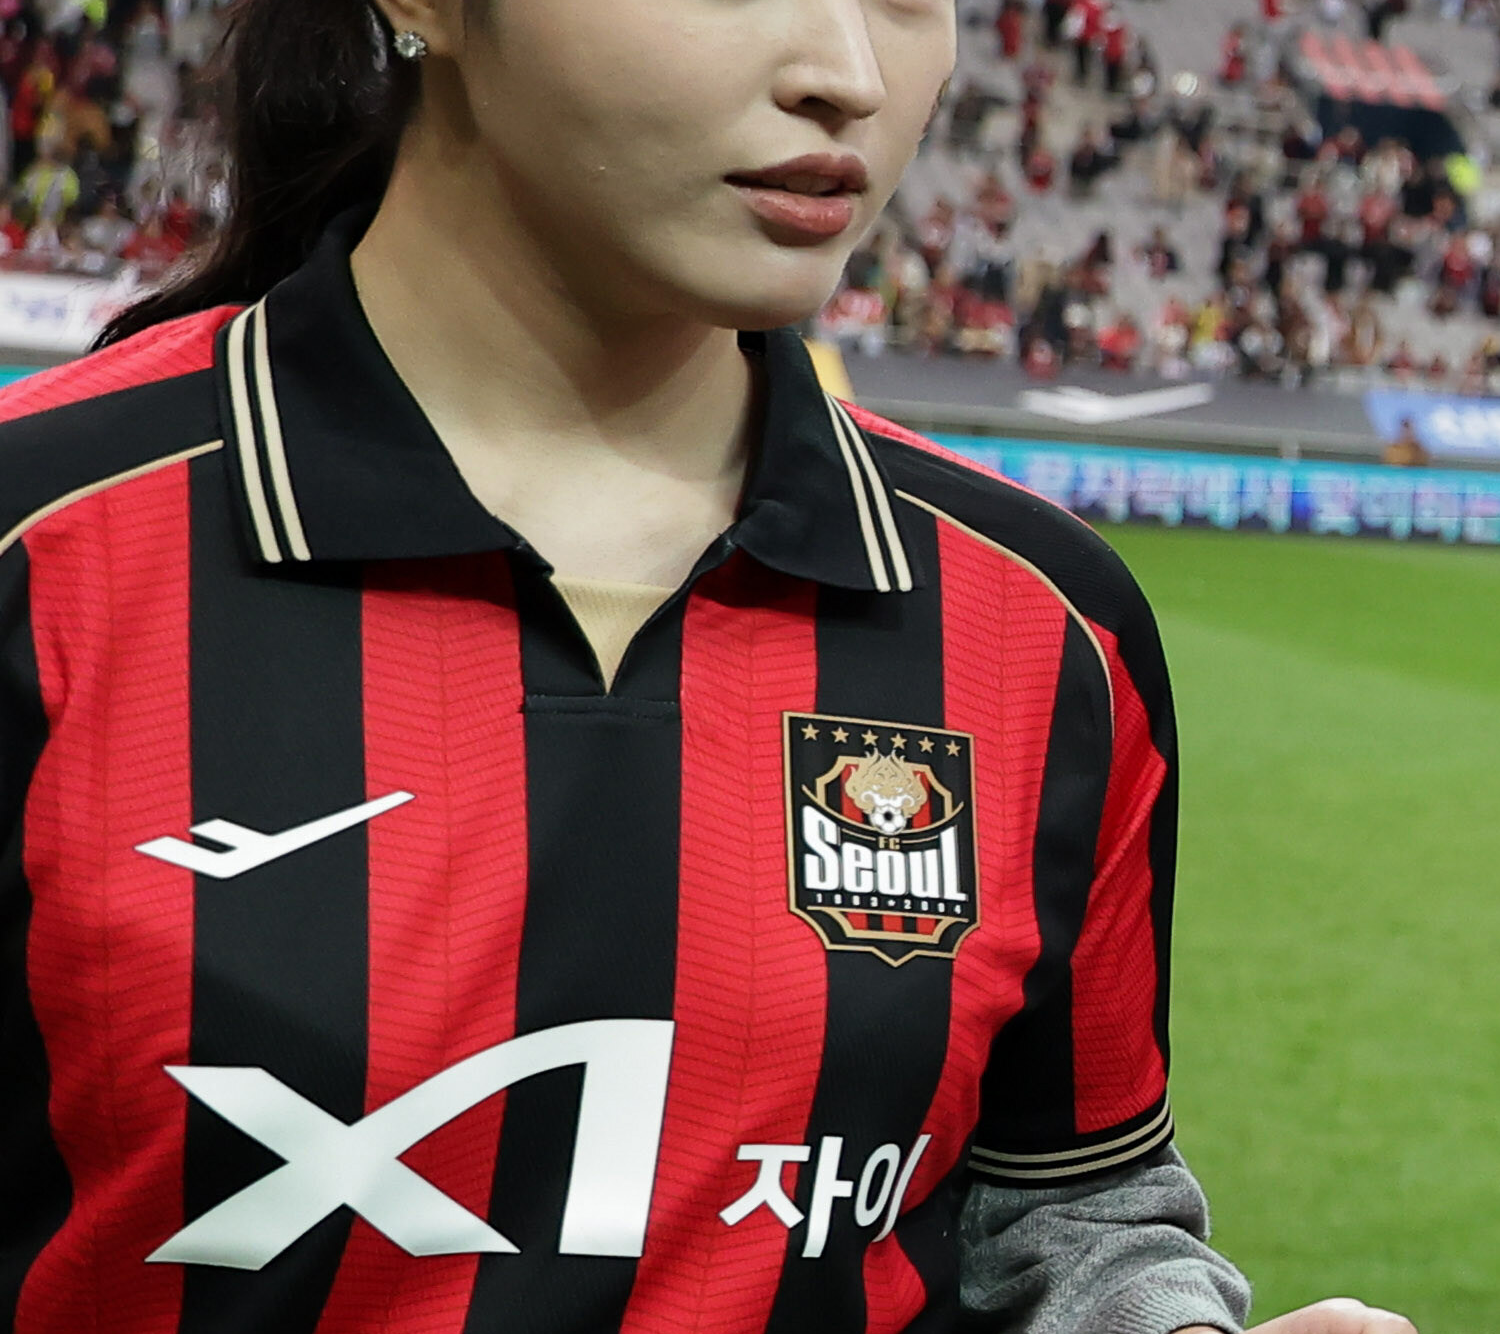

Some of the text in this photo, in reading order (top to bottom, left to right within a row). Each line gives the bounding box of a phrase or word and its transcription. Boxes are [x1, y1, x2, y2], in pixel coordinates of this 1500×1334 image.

[802, 804, 969, 903] Seoul
[879, 836, 901, 851] FC
[718, 1133, 933, 1259] 자이
